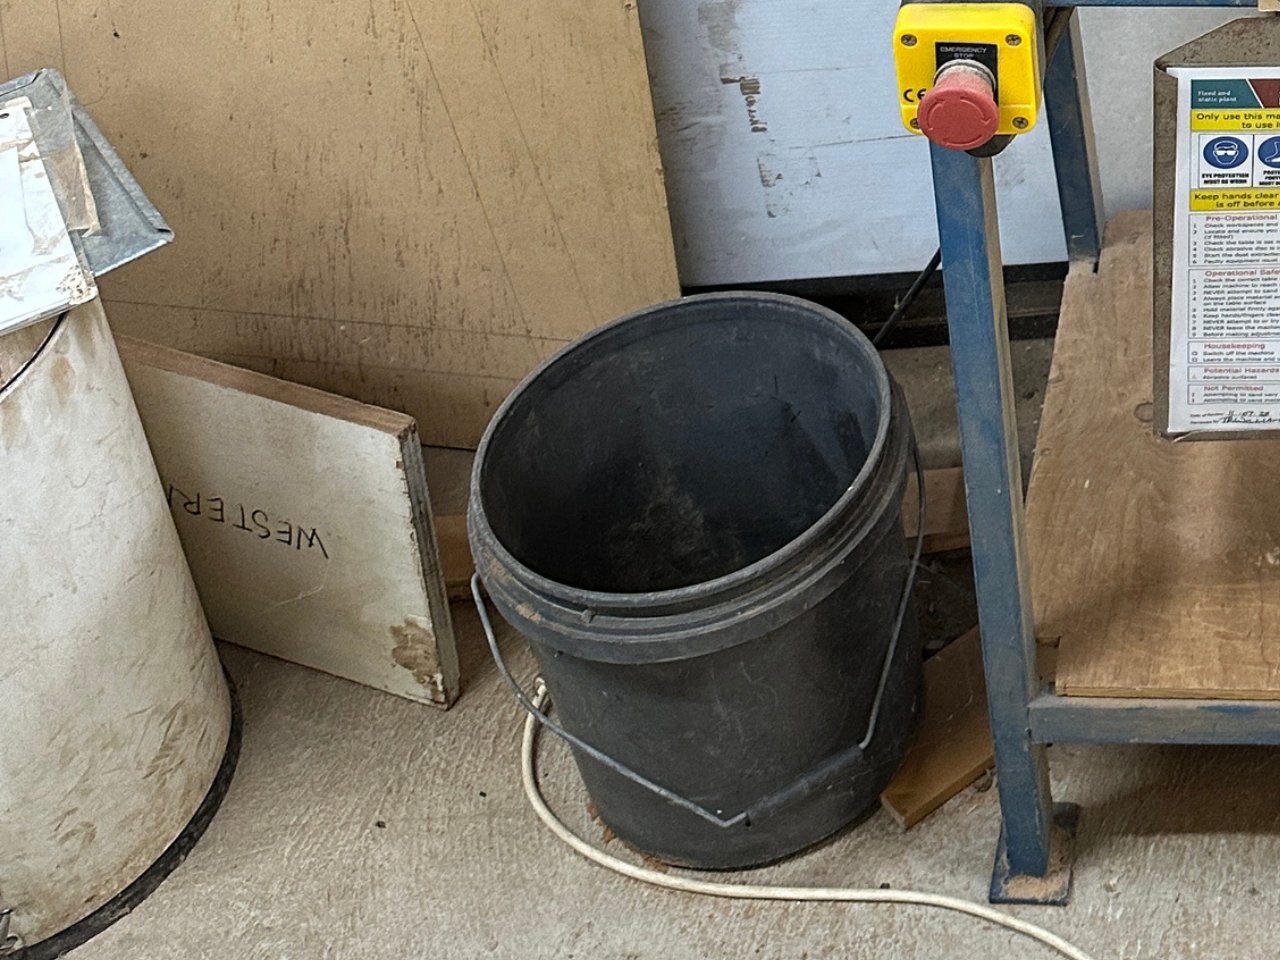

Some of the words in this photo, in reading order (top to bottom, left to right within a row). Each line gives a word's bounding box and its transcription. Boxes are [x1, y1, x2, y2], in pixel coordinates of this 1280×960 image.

[1197, 113, 1219, 122] Only
[1195, 193, 1219, 202] Keep
[1206, 214, 1277, 223] Pre-Operational
[1205, 270, 1256, 278] Operational
[1205, 343, 1266, 351] Housekeeping
